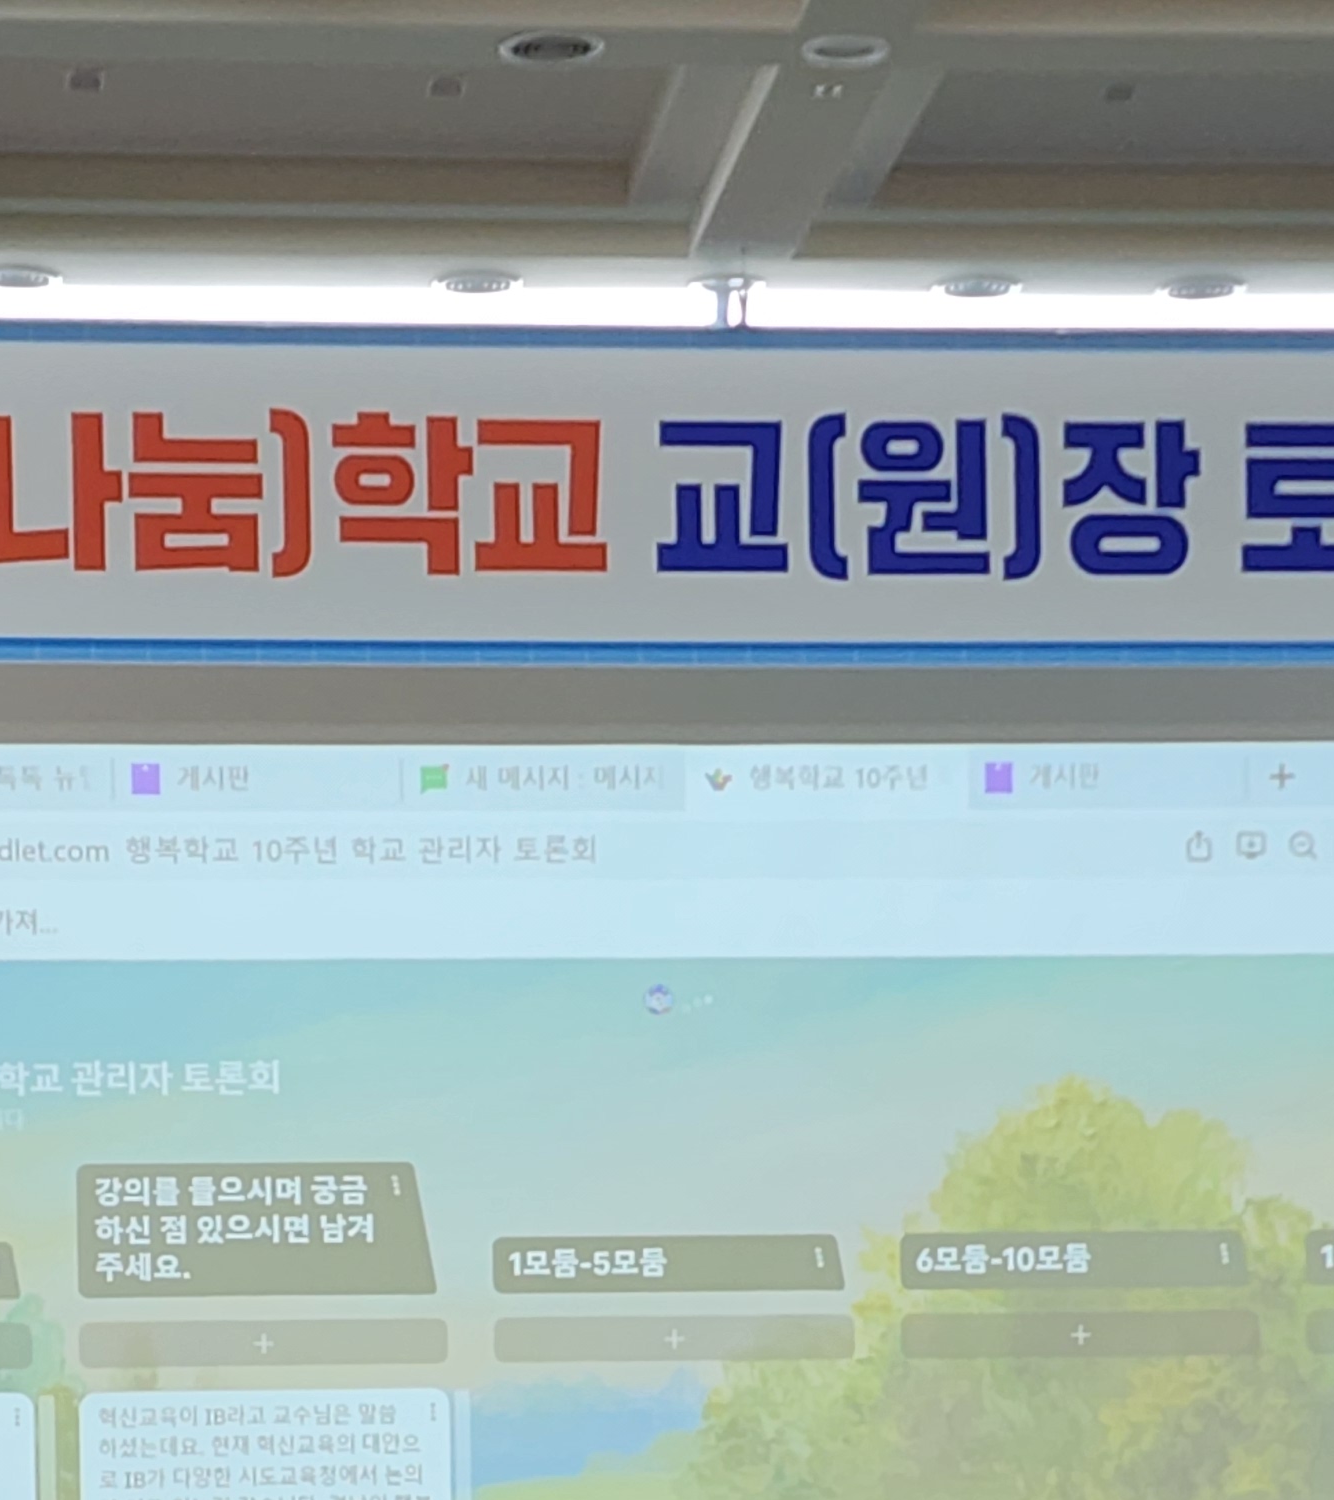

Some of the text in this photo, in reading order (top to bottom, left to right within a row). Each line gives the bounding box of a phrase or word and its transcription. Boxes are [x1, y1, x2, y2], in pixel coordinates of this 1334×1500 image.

[655, 412, 1201, 582] 교(원)장
[177, 765, 250, 792] 게시판
[465, 764, 488, 791] 새
[499, 764, 569, 792] 메시지
[751, 764, 929, 792] 행복학교 10주년
[1028, 764, 1100, 791] 게시판
[125, 834, 598, 866] 행복학교 10주년 학교 관리자 토론회
[71, 1061, 173, 1096] 관리자
[181, 1060, 281, 1096] 토론회
[95, 1175, 368, 1207] 강의를 들으시며 궁금
[95, 1213, 376, 1246] 하신 점 있으시면 남겨
[95, 1254, 191, 1283] 주세요.
[507, 1247, 667, 1279] 1모둠-5모둠
[915, 1243, 1092, 1274] 6모둠-10모둠
[98, 1403, 396, 1427] 혁신교육이 IB라고 교수님은 말씀
[98, 1432, 421, 1459] 하셨는데요. 현재 혁신교육의 대안으
[125, 1469, 165, 1490] IB가
[173, 1467, 231, 1489] 다양한
[239, 1465, 377, 1487] 시도교육청에서
